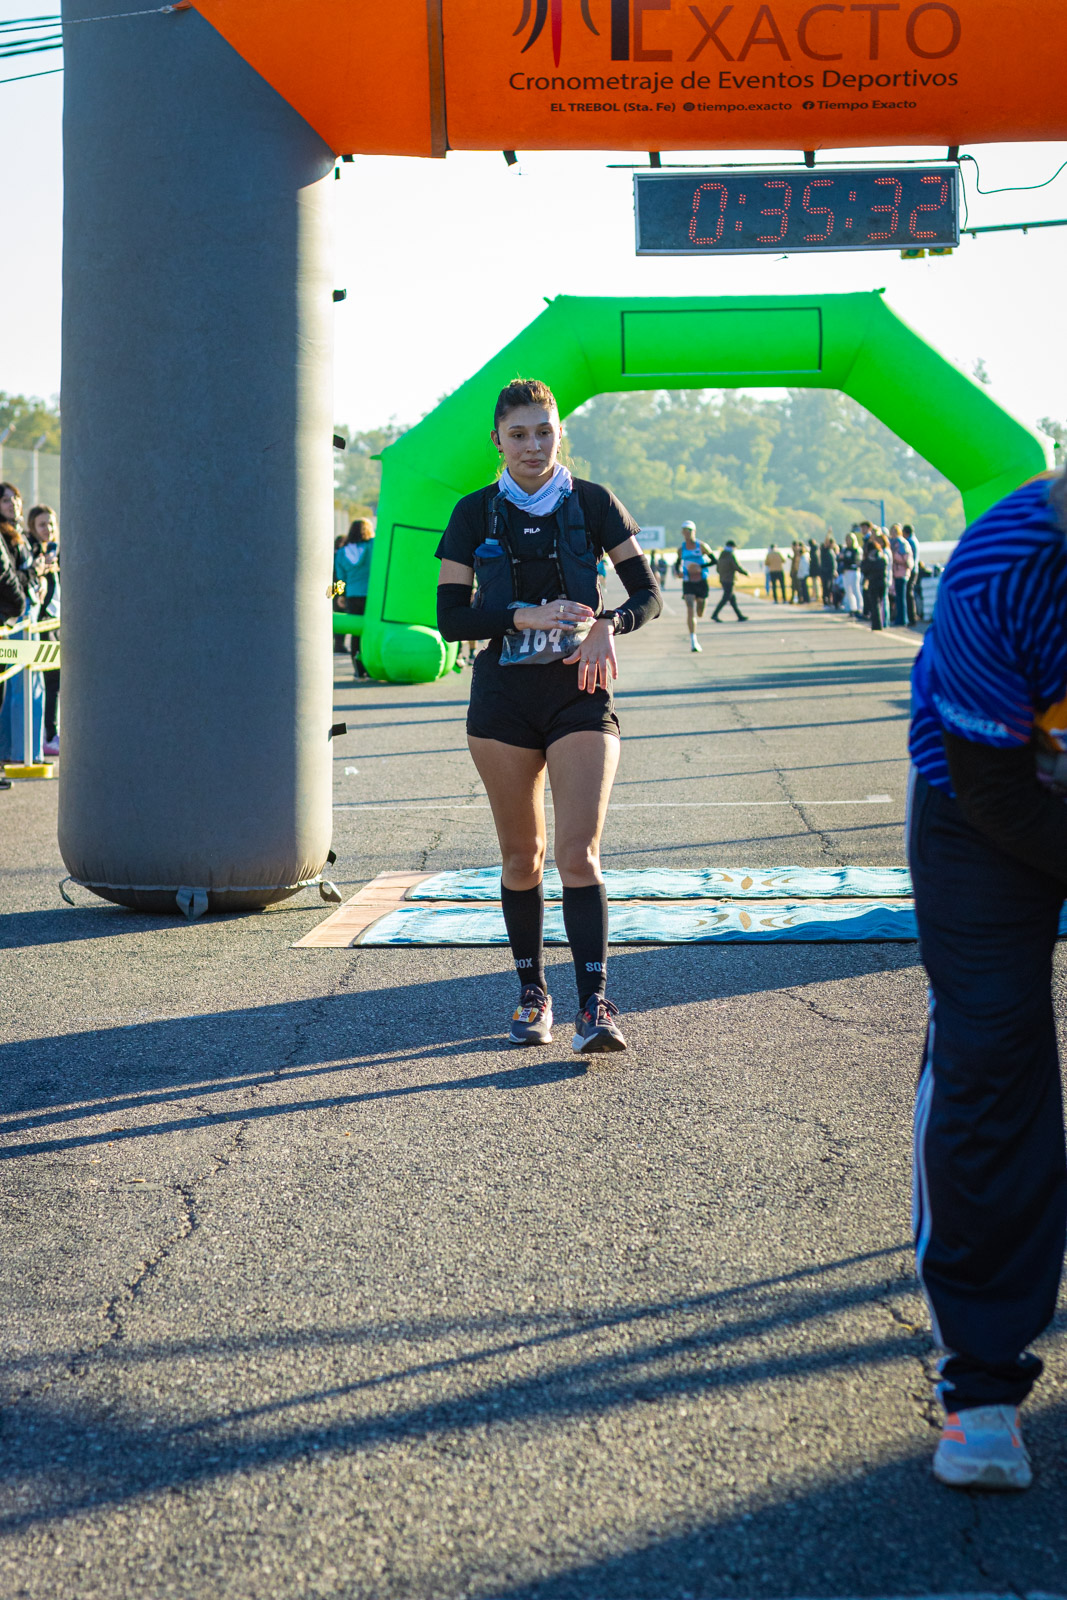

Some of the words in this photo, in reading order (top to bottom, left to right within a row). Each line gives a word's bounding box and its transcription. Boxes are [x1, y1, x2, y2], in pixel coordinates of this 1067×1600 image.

[509, 71, 673, 93] Cronometraje
[680, 71, 711, 89] de
[718, 71, 814, 89] Eventos
[822, 69, 958, 91] Deportivos
[551, 103, 566, 112] EL
[568, 103, 620, 112] TREBOL
[623, 102, 652, 113] (Sta.
[656, 102, 676, 113] Fe)
[697, 101, 792, 112] tiempo.exacto
[817, 100, 869, 111] Tiempo
[872, 100, 917, 109] Exacto
[688, 176, 949, 245] 0:35:32
